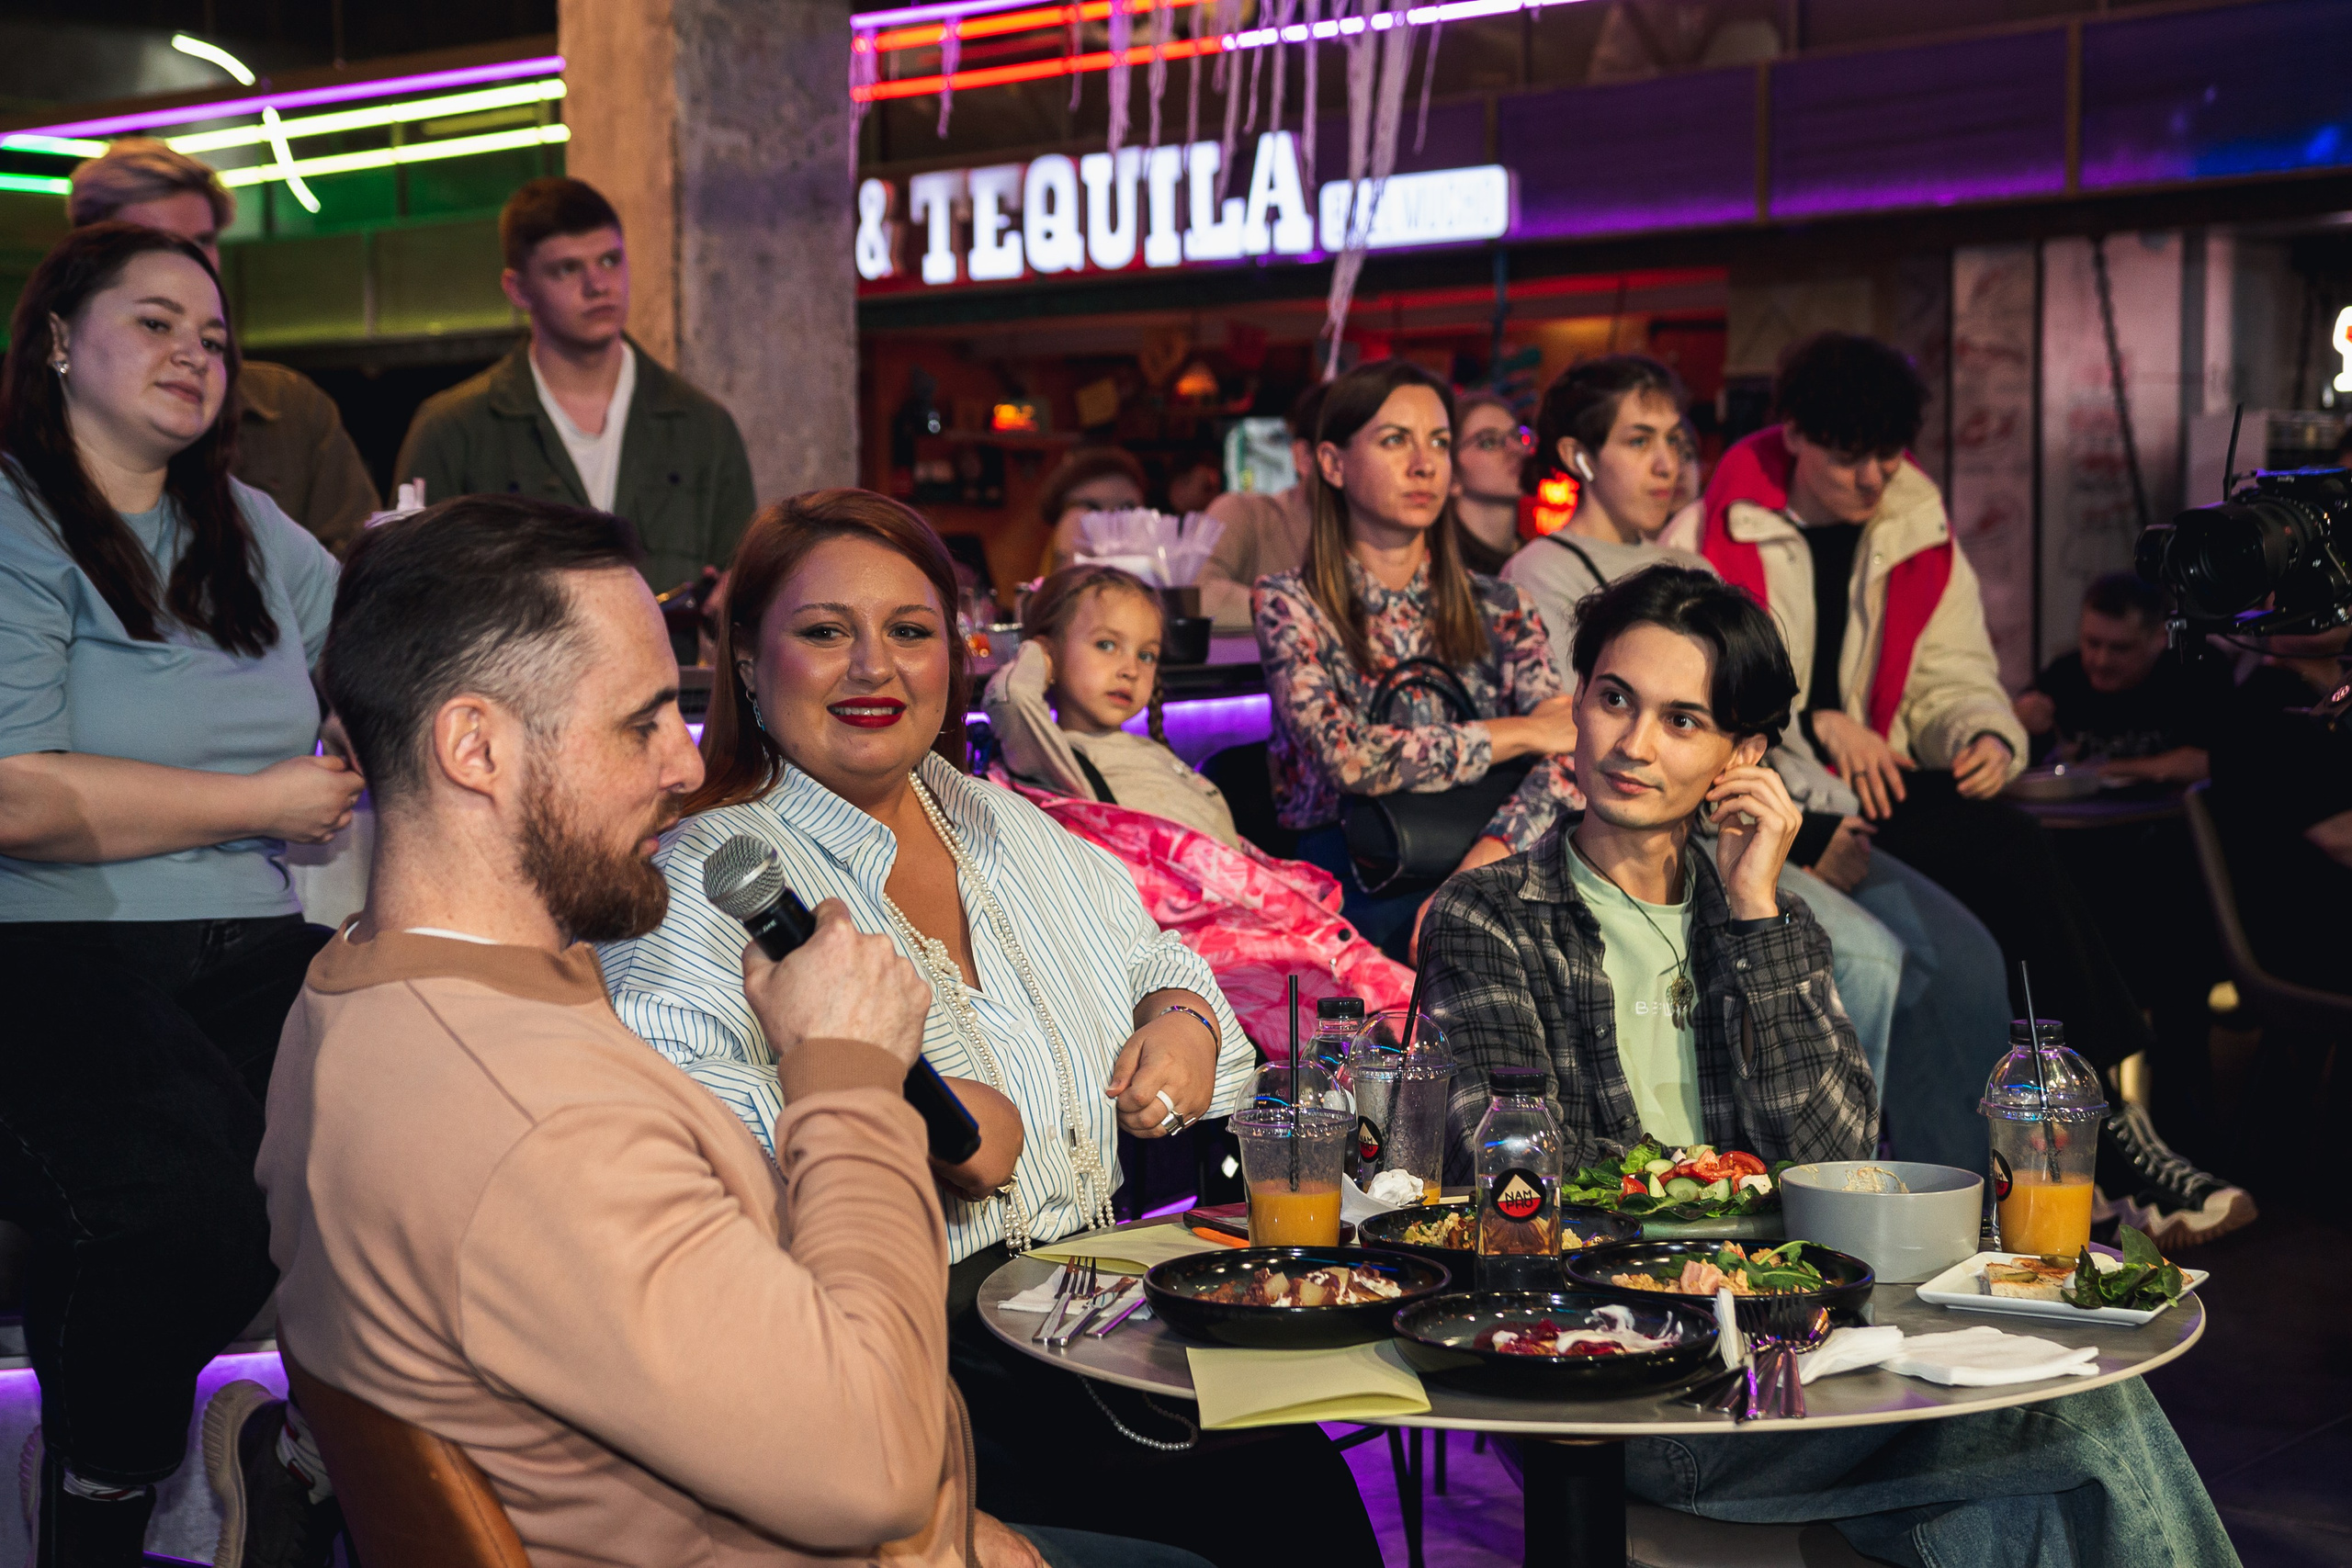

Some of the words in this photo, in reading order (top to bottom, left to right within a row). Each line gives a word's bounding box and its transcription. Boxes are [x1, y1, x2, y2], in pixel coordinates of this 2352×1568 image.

[855, 177, 894, 280] &
[909, 130, 1315, 286] TEQUILA
[1504, 1189, 1533, 1201] NAM
